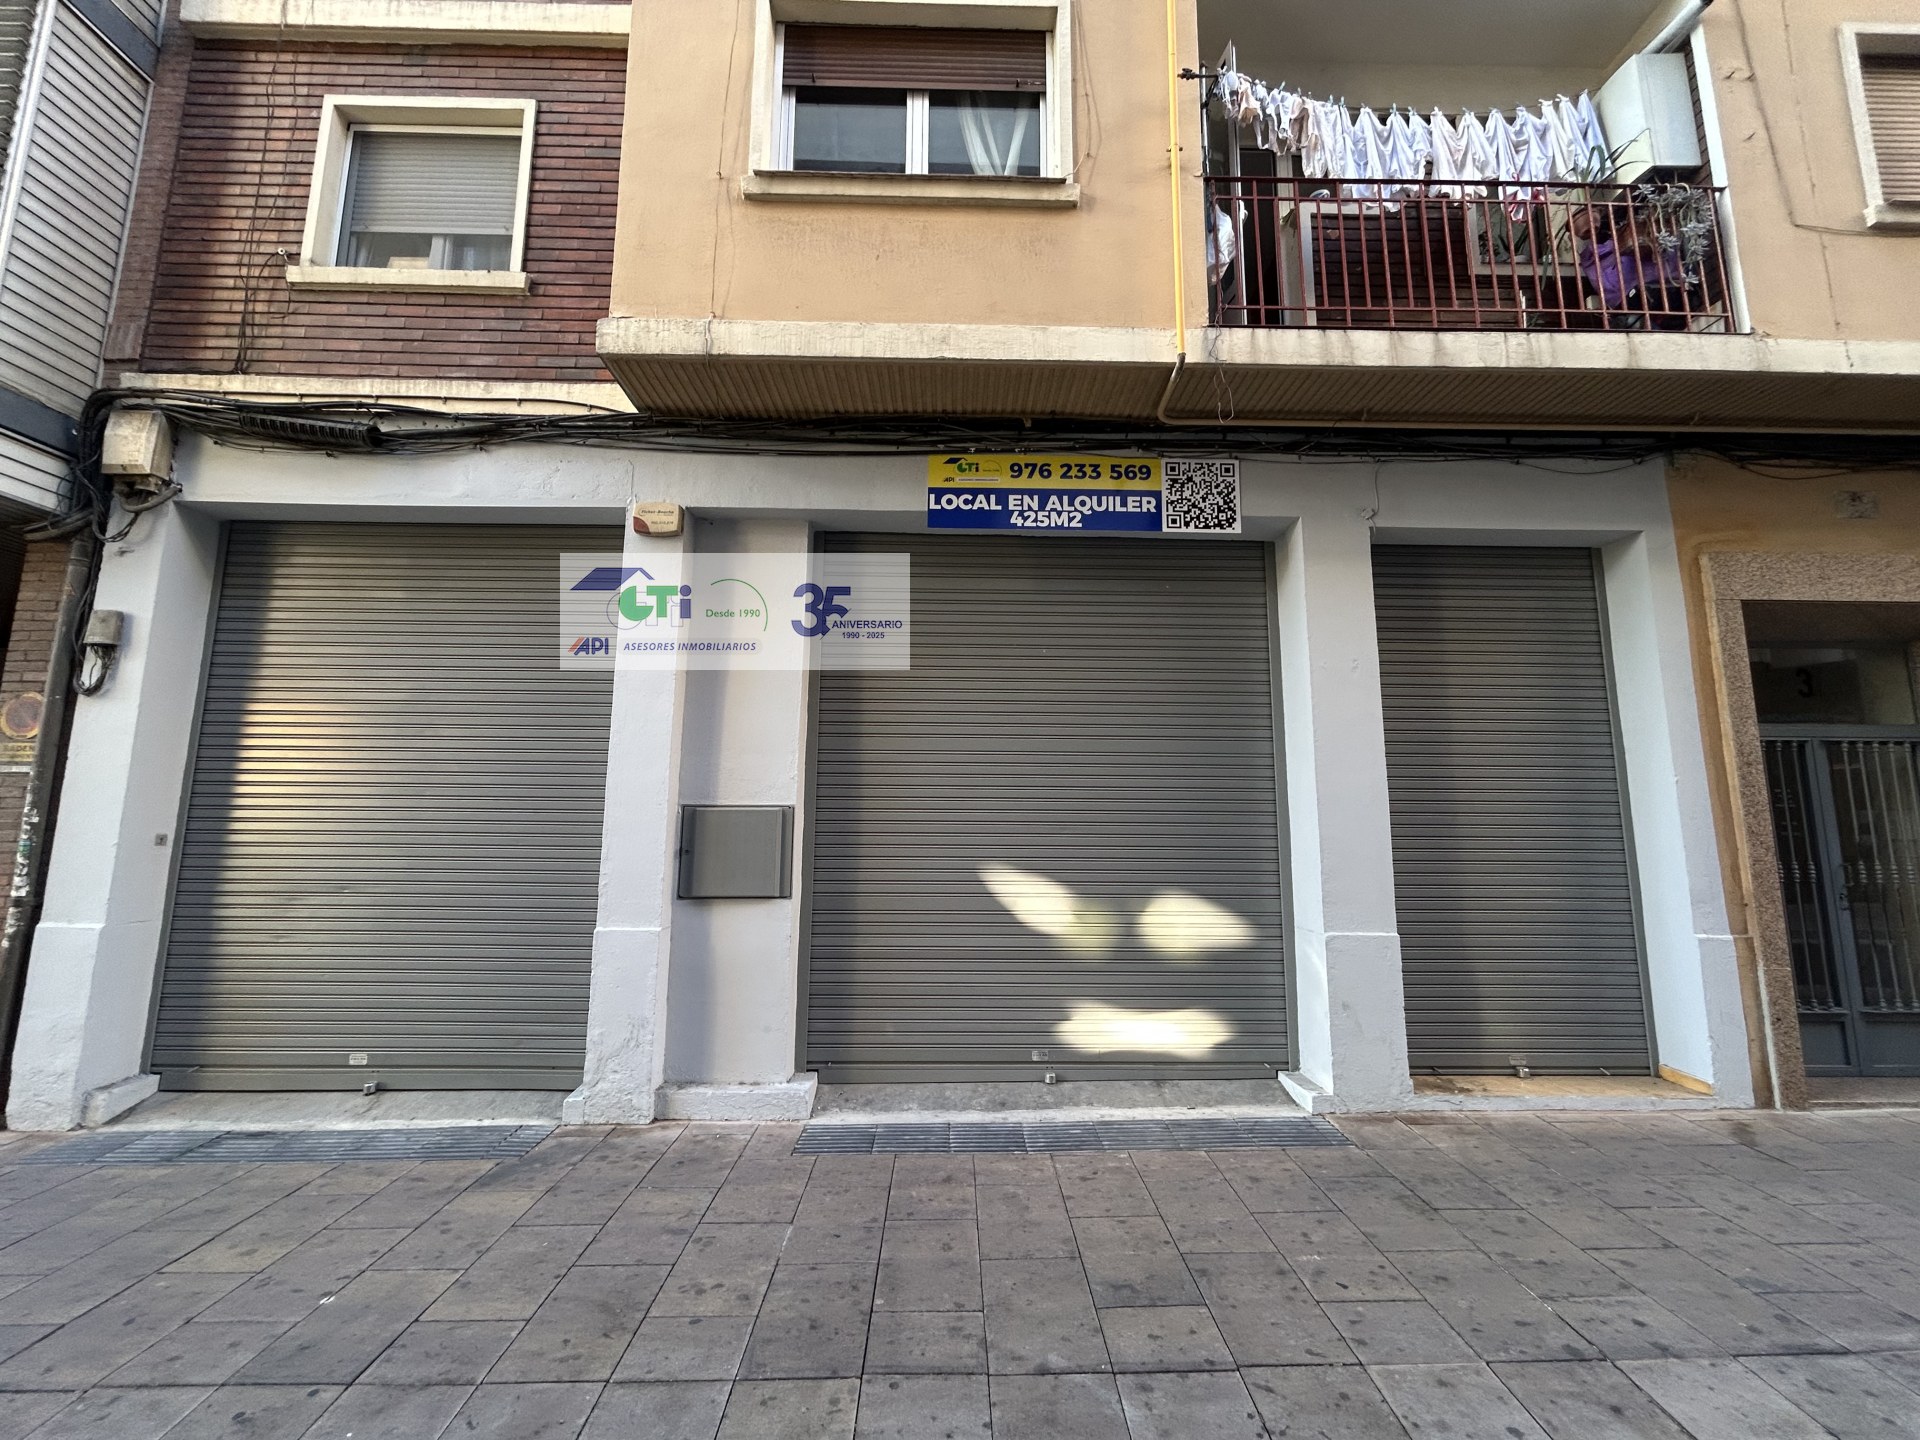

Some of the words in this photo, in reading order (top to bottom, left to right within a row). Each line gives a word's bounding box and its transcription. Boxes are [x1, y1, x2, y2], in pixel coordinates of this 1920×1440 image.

[1009, 462, 1052, 480] 976
[1059, 463, 1101, 480] 233
[1109, 464, 1151, 481] 569
[929, 493, 1002, 511] LOCAL
[1009, 495, 1039, 511] EN
[1045, 496, 1157, 515] ALQUILER
[1010, 511, 1083, 528] 425M2
[1796, 668, 1813, 698] 3
